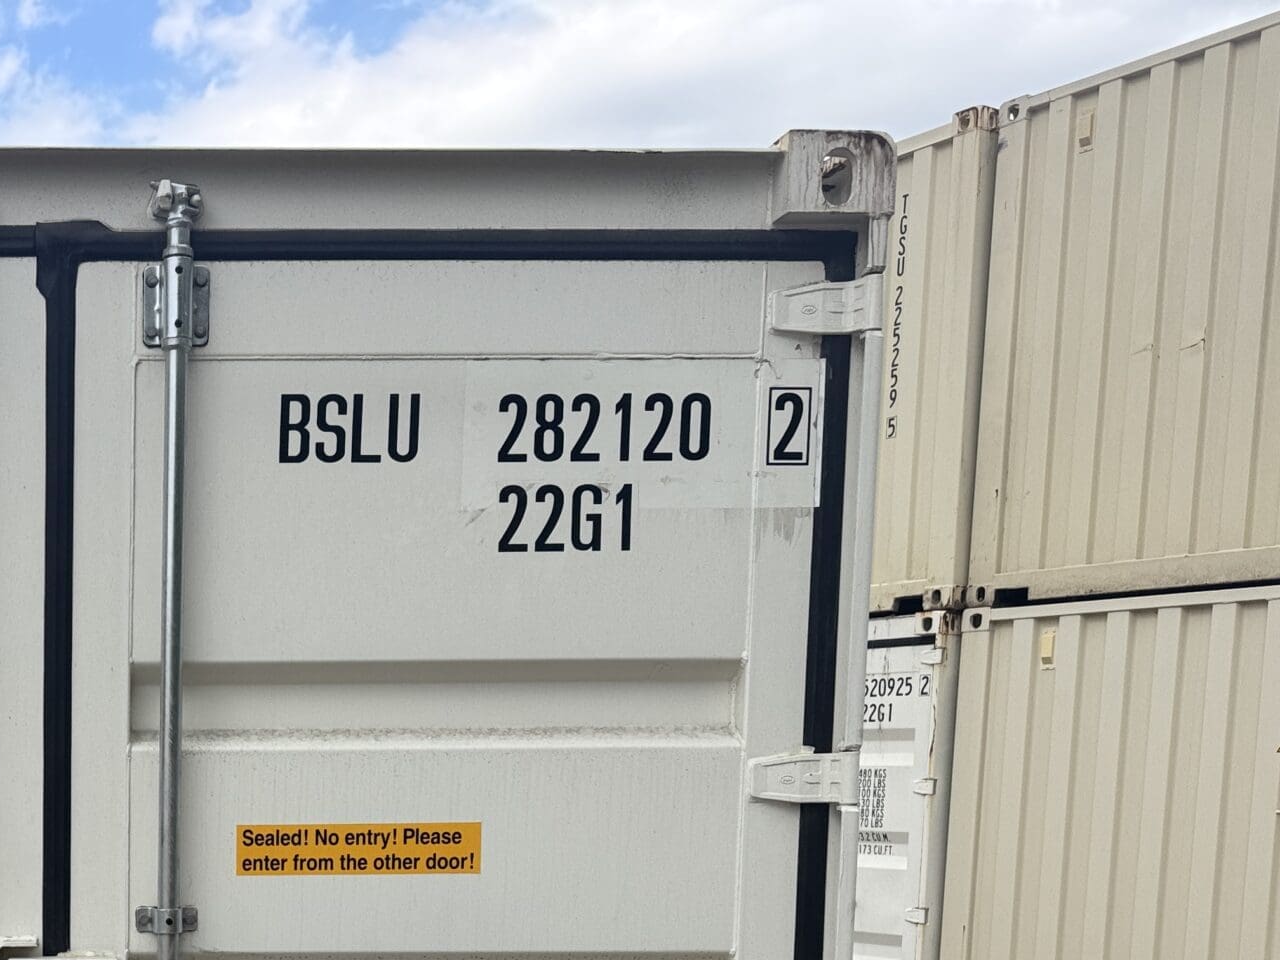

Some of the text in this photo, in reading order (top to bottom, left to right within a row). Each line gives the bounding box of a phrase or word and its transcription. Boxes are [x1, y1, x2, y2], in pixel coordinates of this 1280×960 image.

[887, 193, 910, 438] TGSU 225259 5
[278, 392, 804, 464] BSLU 282120 2
[497, 483, 634, 552] 22G1
[920, 675, 929, 696] 2
[874, 768, 887, 778] KGS
[873, 779, 886, 789] LBS
[873, 788, 886, 798] KGS
[242, 828, 462, 849] Sealed! No entry! Please
[242, 853, 474, 871] enter from the other door!
